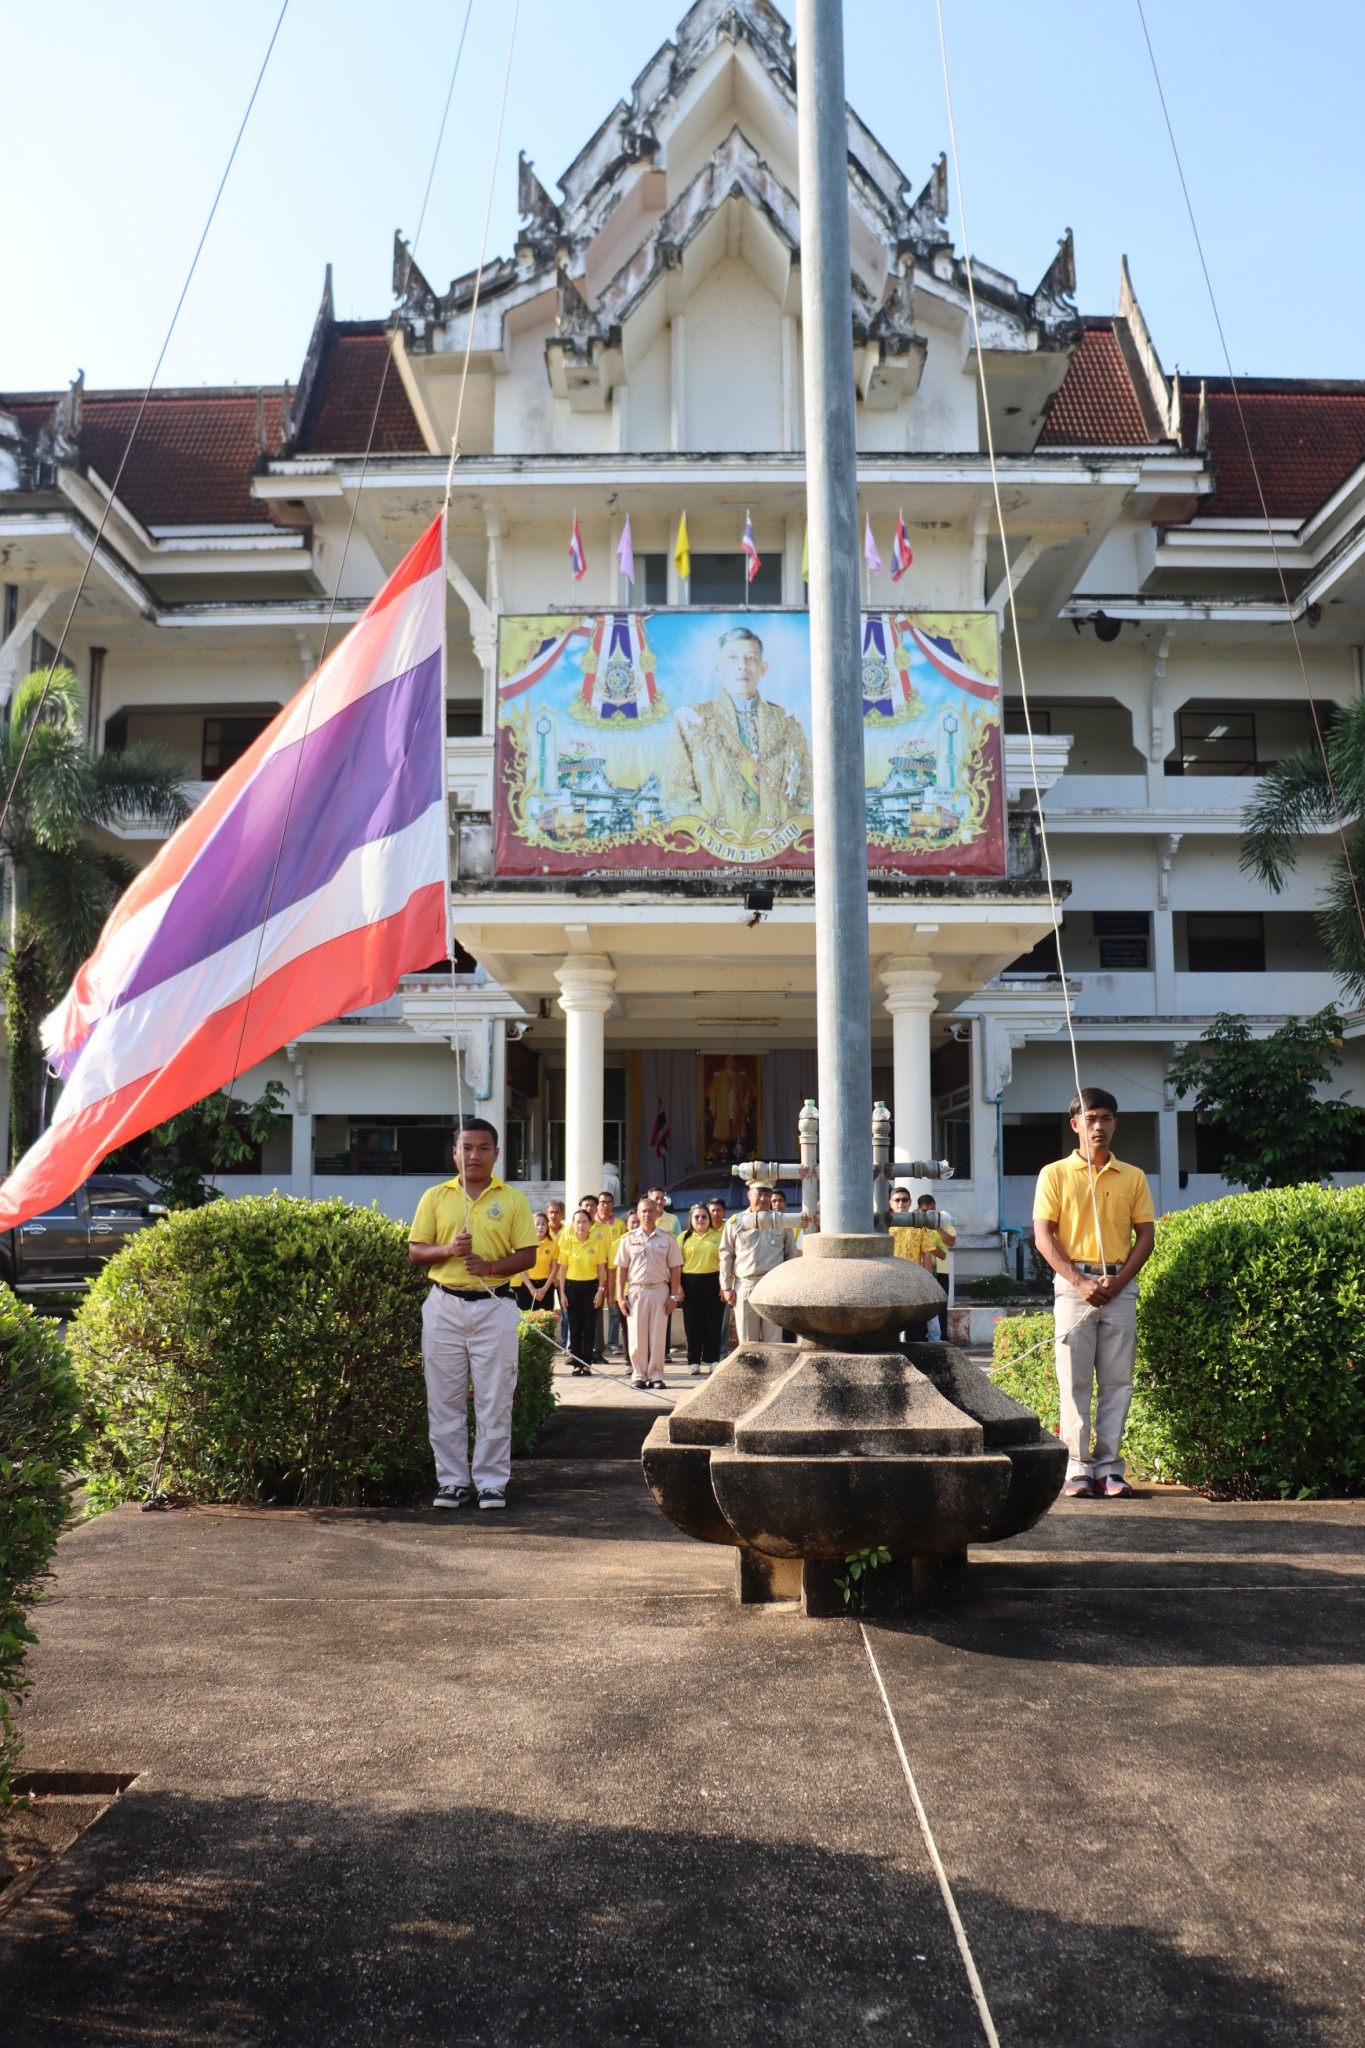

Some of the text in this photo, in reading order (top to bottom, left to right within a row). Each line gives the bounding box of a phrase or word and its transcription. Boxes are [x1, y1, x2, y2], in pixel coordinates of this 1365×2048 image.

[696, 823, 801, 861] ทรงพระเจริญ
